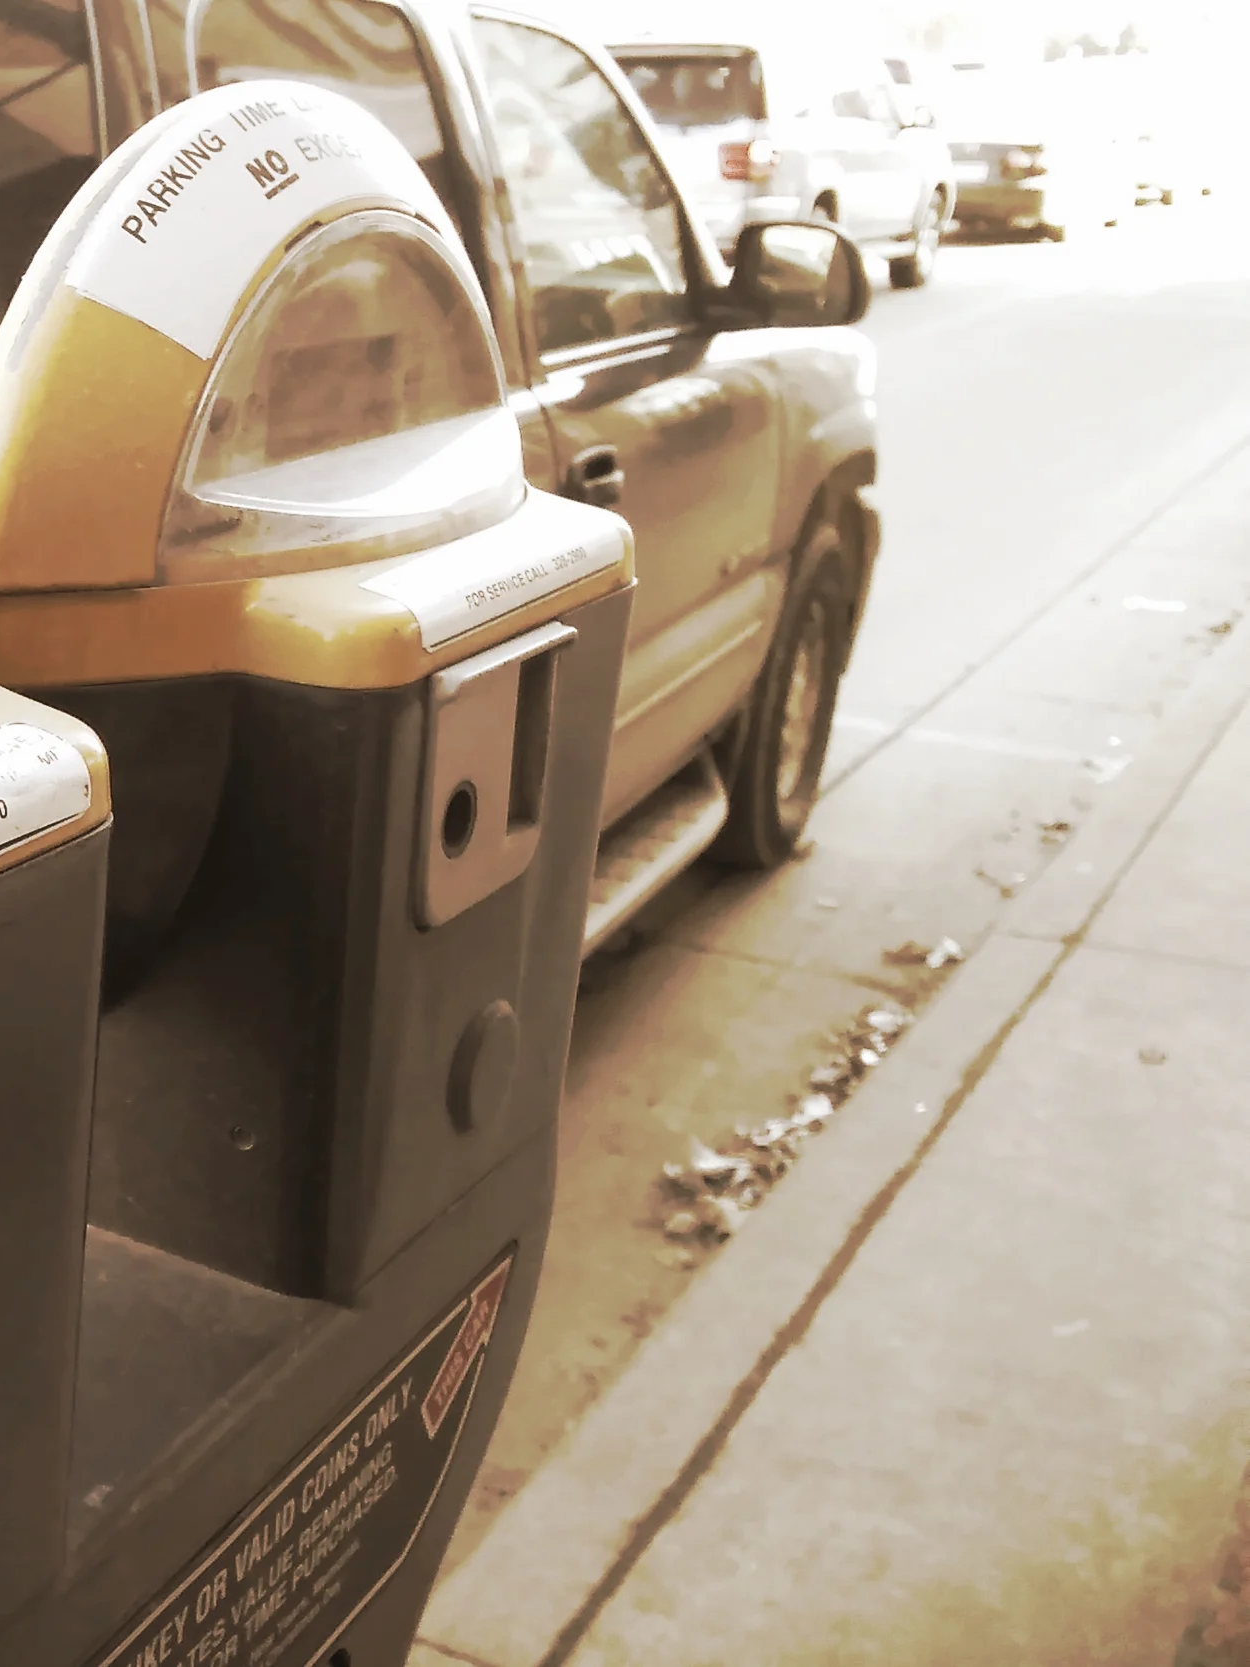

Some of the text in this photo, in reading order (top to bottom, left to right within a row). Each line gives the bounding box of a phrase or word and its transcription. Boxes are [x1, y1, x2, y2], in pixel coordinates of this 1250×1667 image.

[121, 129, 227, 244] PARKING
[245, 149, 290, 189] NO
[465, 590, 487, 610] FOR
[486, 573, 526, 600] SERVICE
[195, 1568, 228, 1623] OR
[234, 1498, 295, 1582] VALID
[302, 1432, 360, 1513] COINS
[364, 1377, 416, 1447] ONLY.
[231, 1544, 294, 1624] VALUE
[299, 1442, 393, 1556] REMAINING
[245, 1580, 288, 1641] TIME
